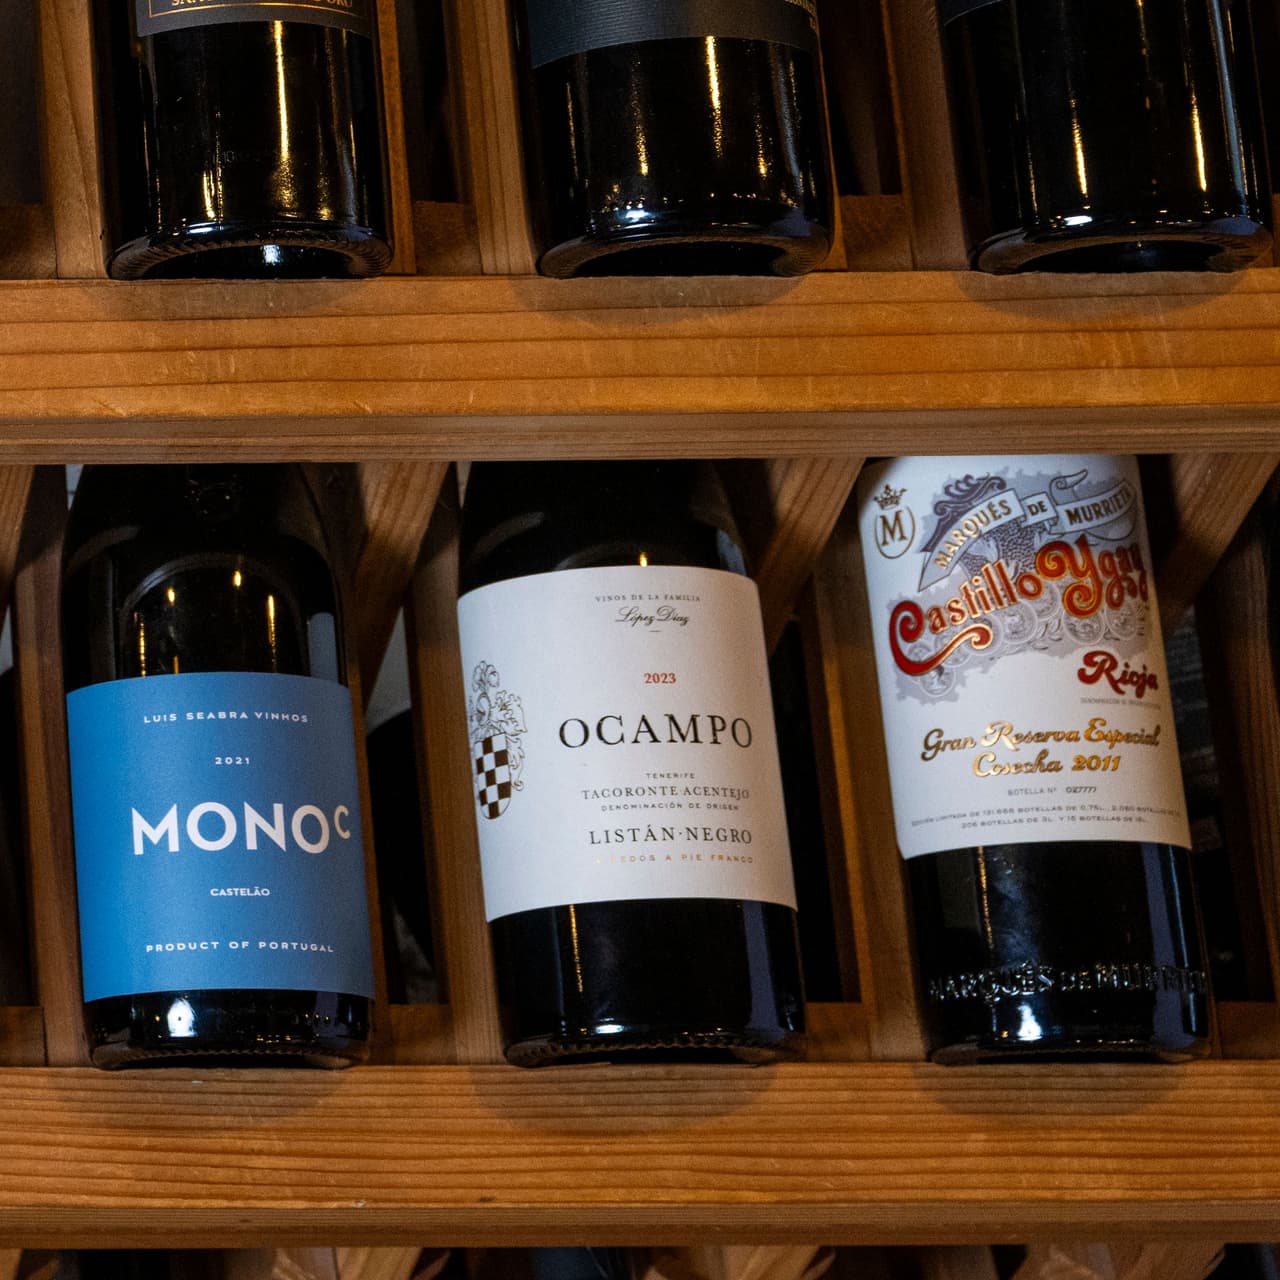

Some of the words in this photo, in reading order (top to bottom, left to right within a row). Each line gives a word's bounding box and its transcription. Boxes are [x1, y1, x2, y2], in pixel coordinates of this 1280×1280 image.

[932, 498, 1014, 571] MARQUÉS
[1027, 500, 1047, 517] DE
[889, 559, 1045, 678] Castillo
[644, 672, 677, 685] 2023
[1077, 649, 1160, 700] Rioja
[144, 713, 177, 724] LUIS
[186, 712, 248, 720] SEABRA
[255, 712, 309, 723] VINHOS
[559, 714, 752, 749] OCAMPO
[920, 728, 976, 762] Gran
[980, 721, 1080, 752] Reserva
[1083, 717, 1161, 748] Especial
[215, 757, 250, 765] 2021
[972, 748, 1063, 779] Cosecha
[1071, 755, 1121, 774] 2011
[210, 886, 270, 897] CASTELÃO
[146, 941, 219, 953] PRODUCT
[229, 941, 249, 949] OF
[259, 941, 334, 953] PORTUGAL
